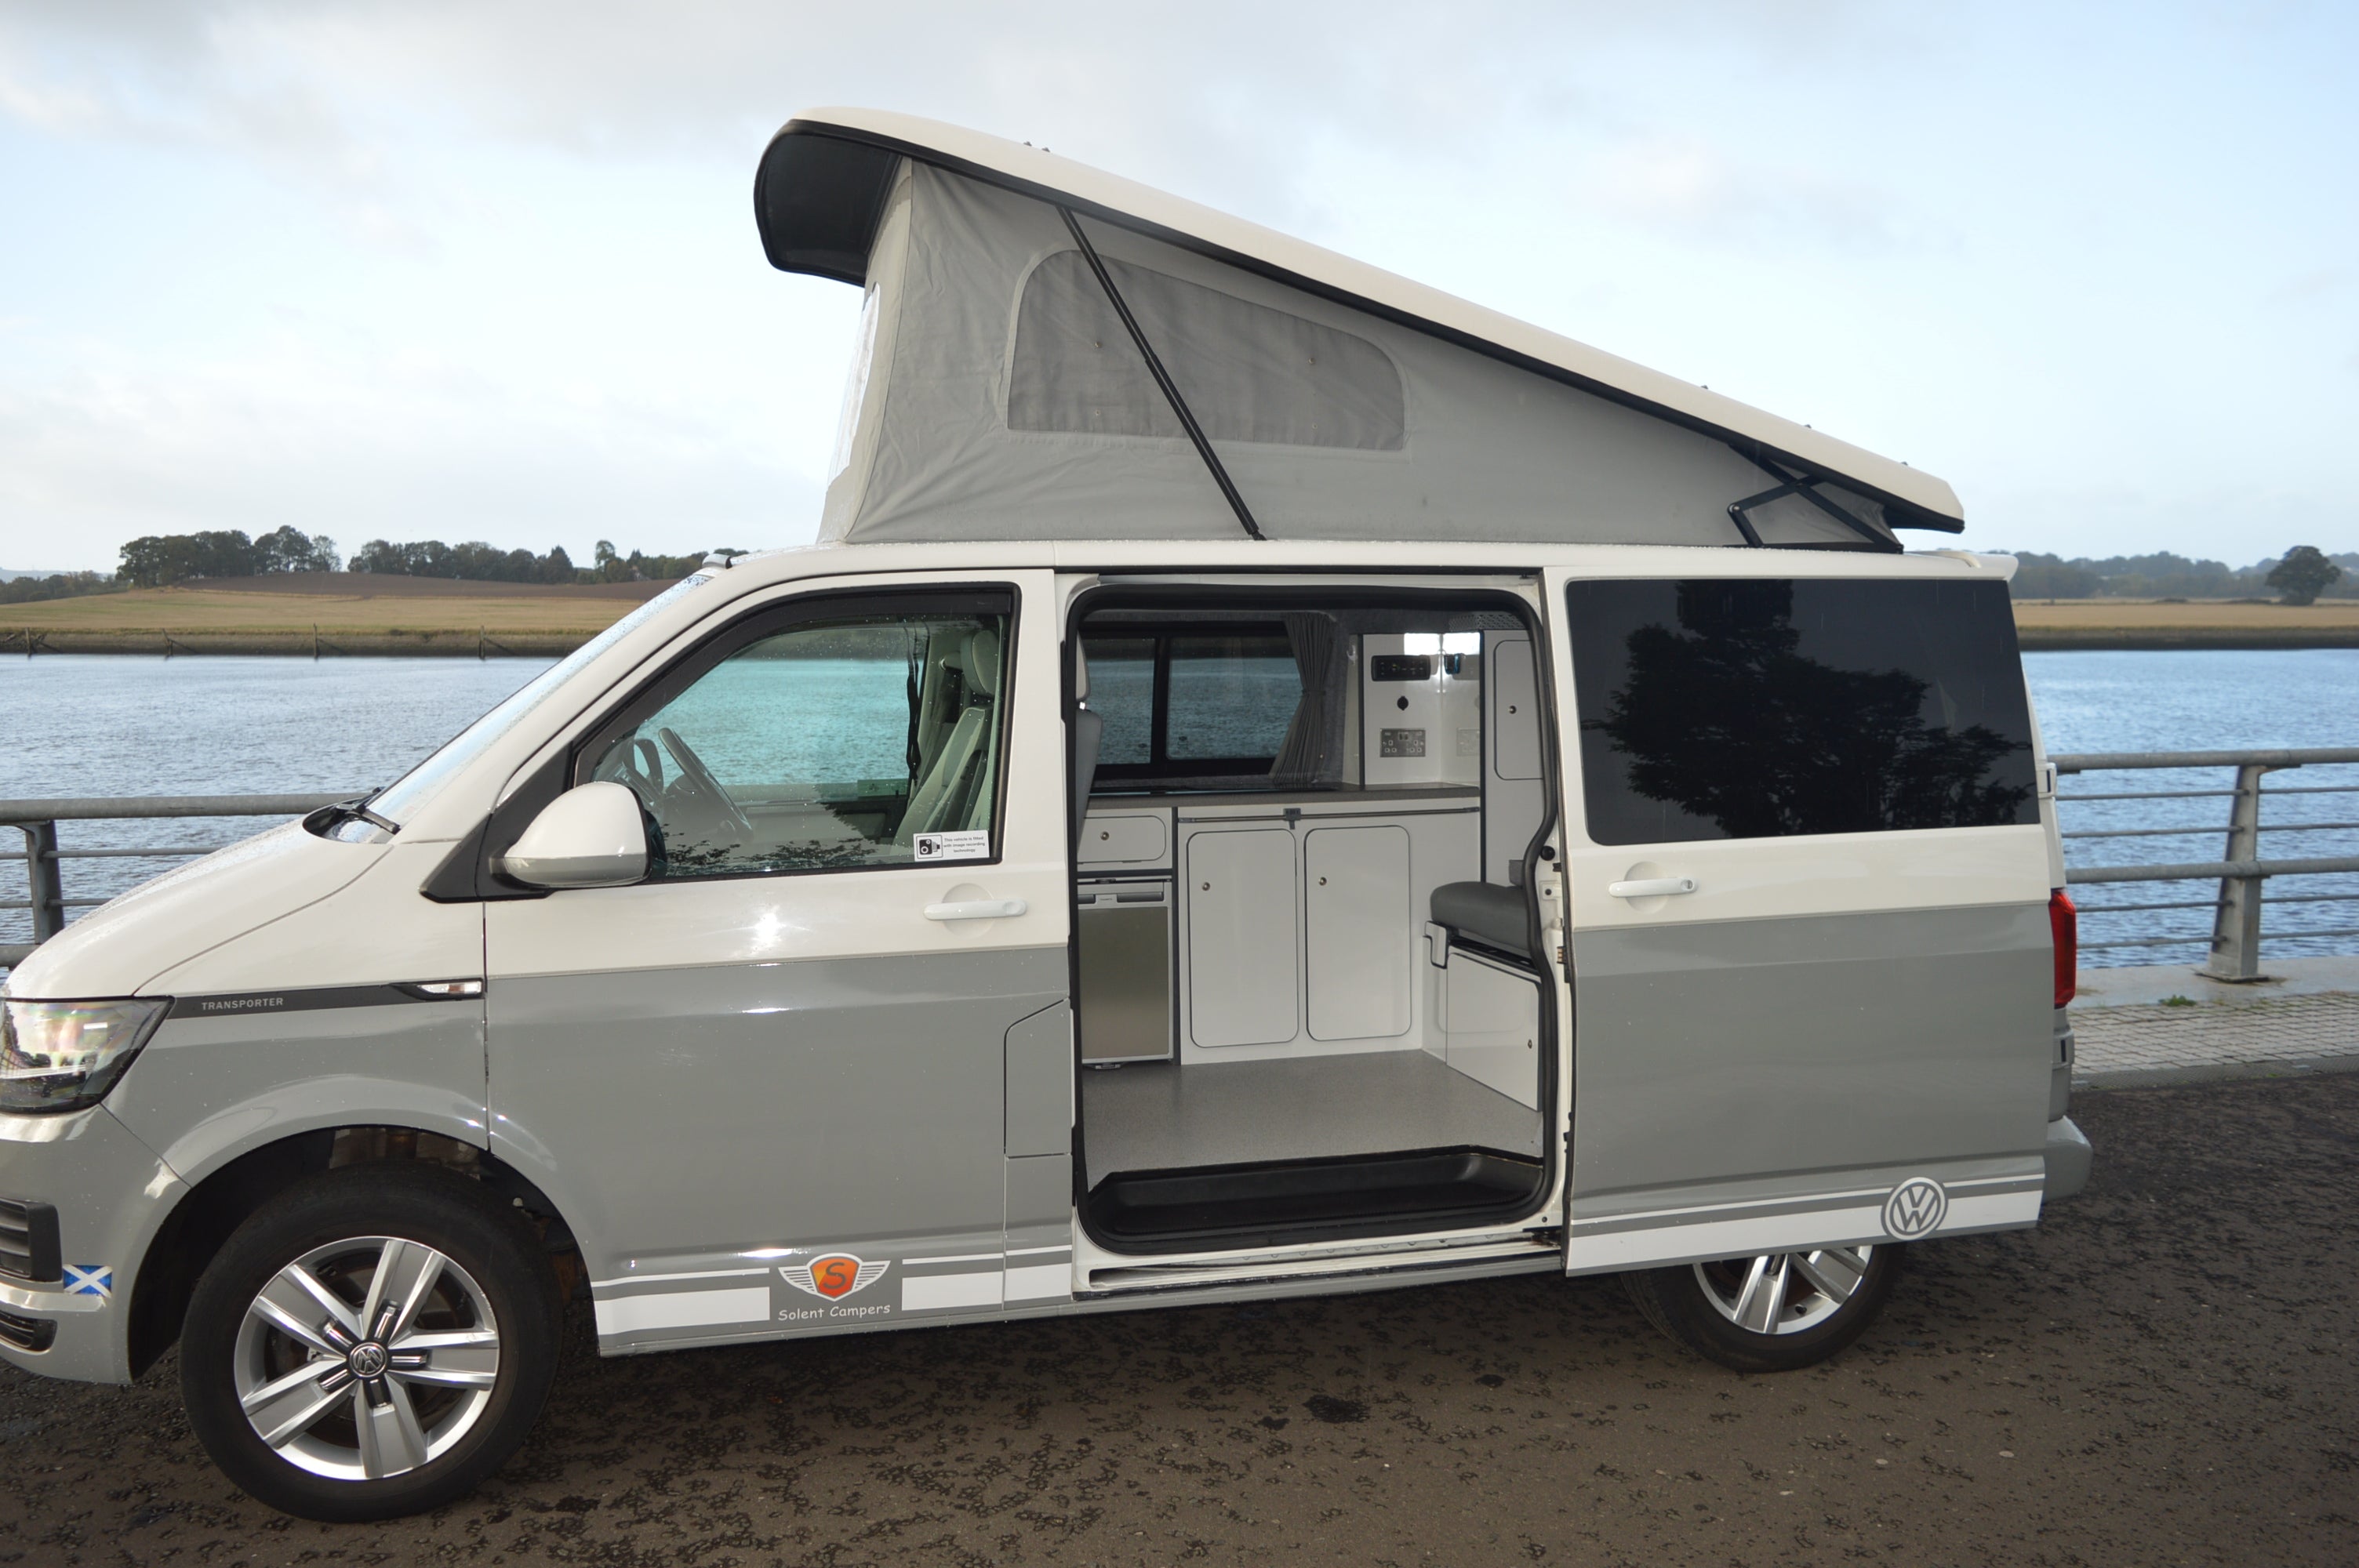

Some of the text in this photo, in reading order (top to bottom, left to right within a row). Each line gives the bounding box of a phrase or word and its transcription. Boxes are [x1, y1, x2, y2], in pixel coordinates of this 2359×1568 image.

[202, 997, 284, 1011] TRANSPORTER
[1890, 1182, 1940, 1235] VW
[823, 1262, 846, 1289] S
[778, 1305, 891, 1321] Solent Campers
